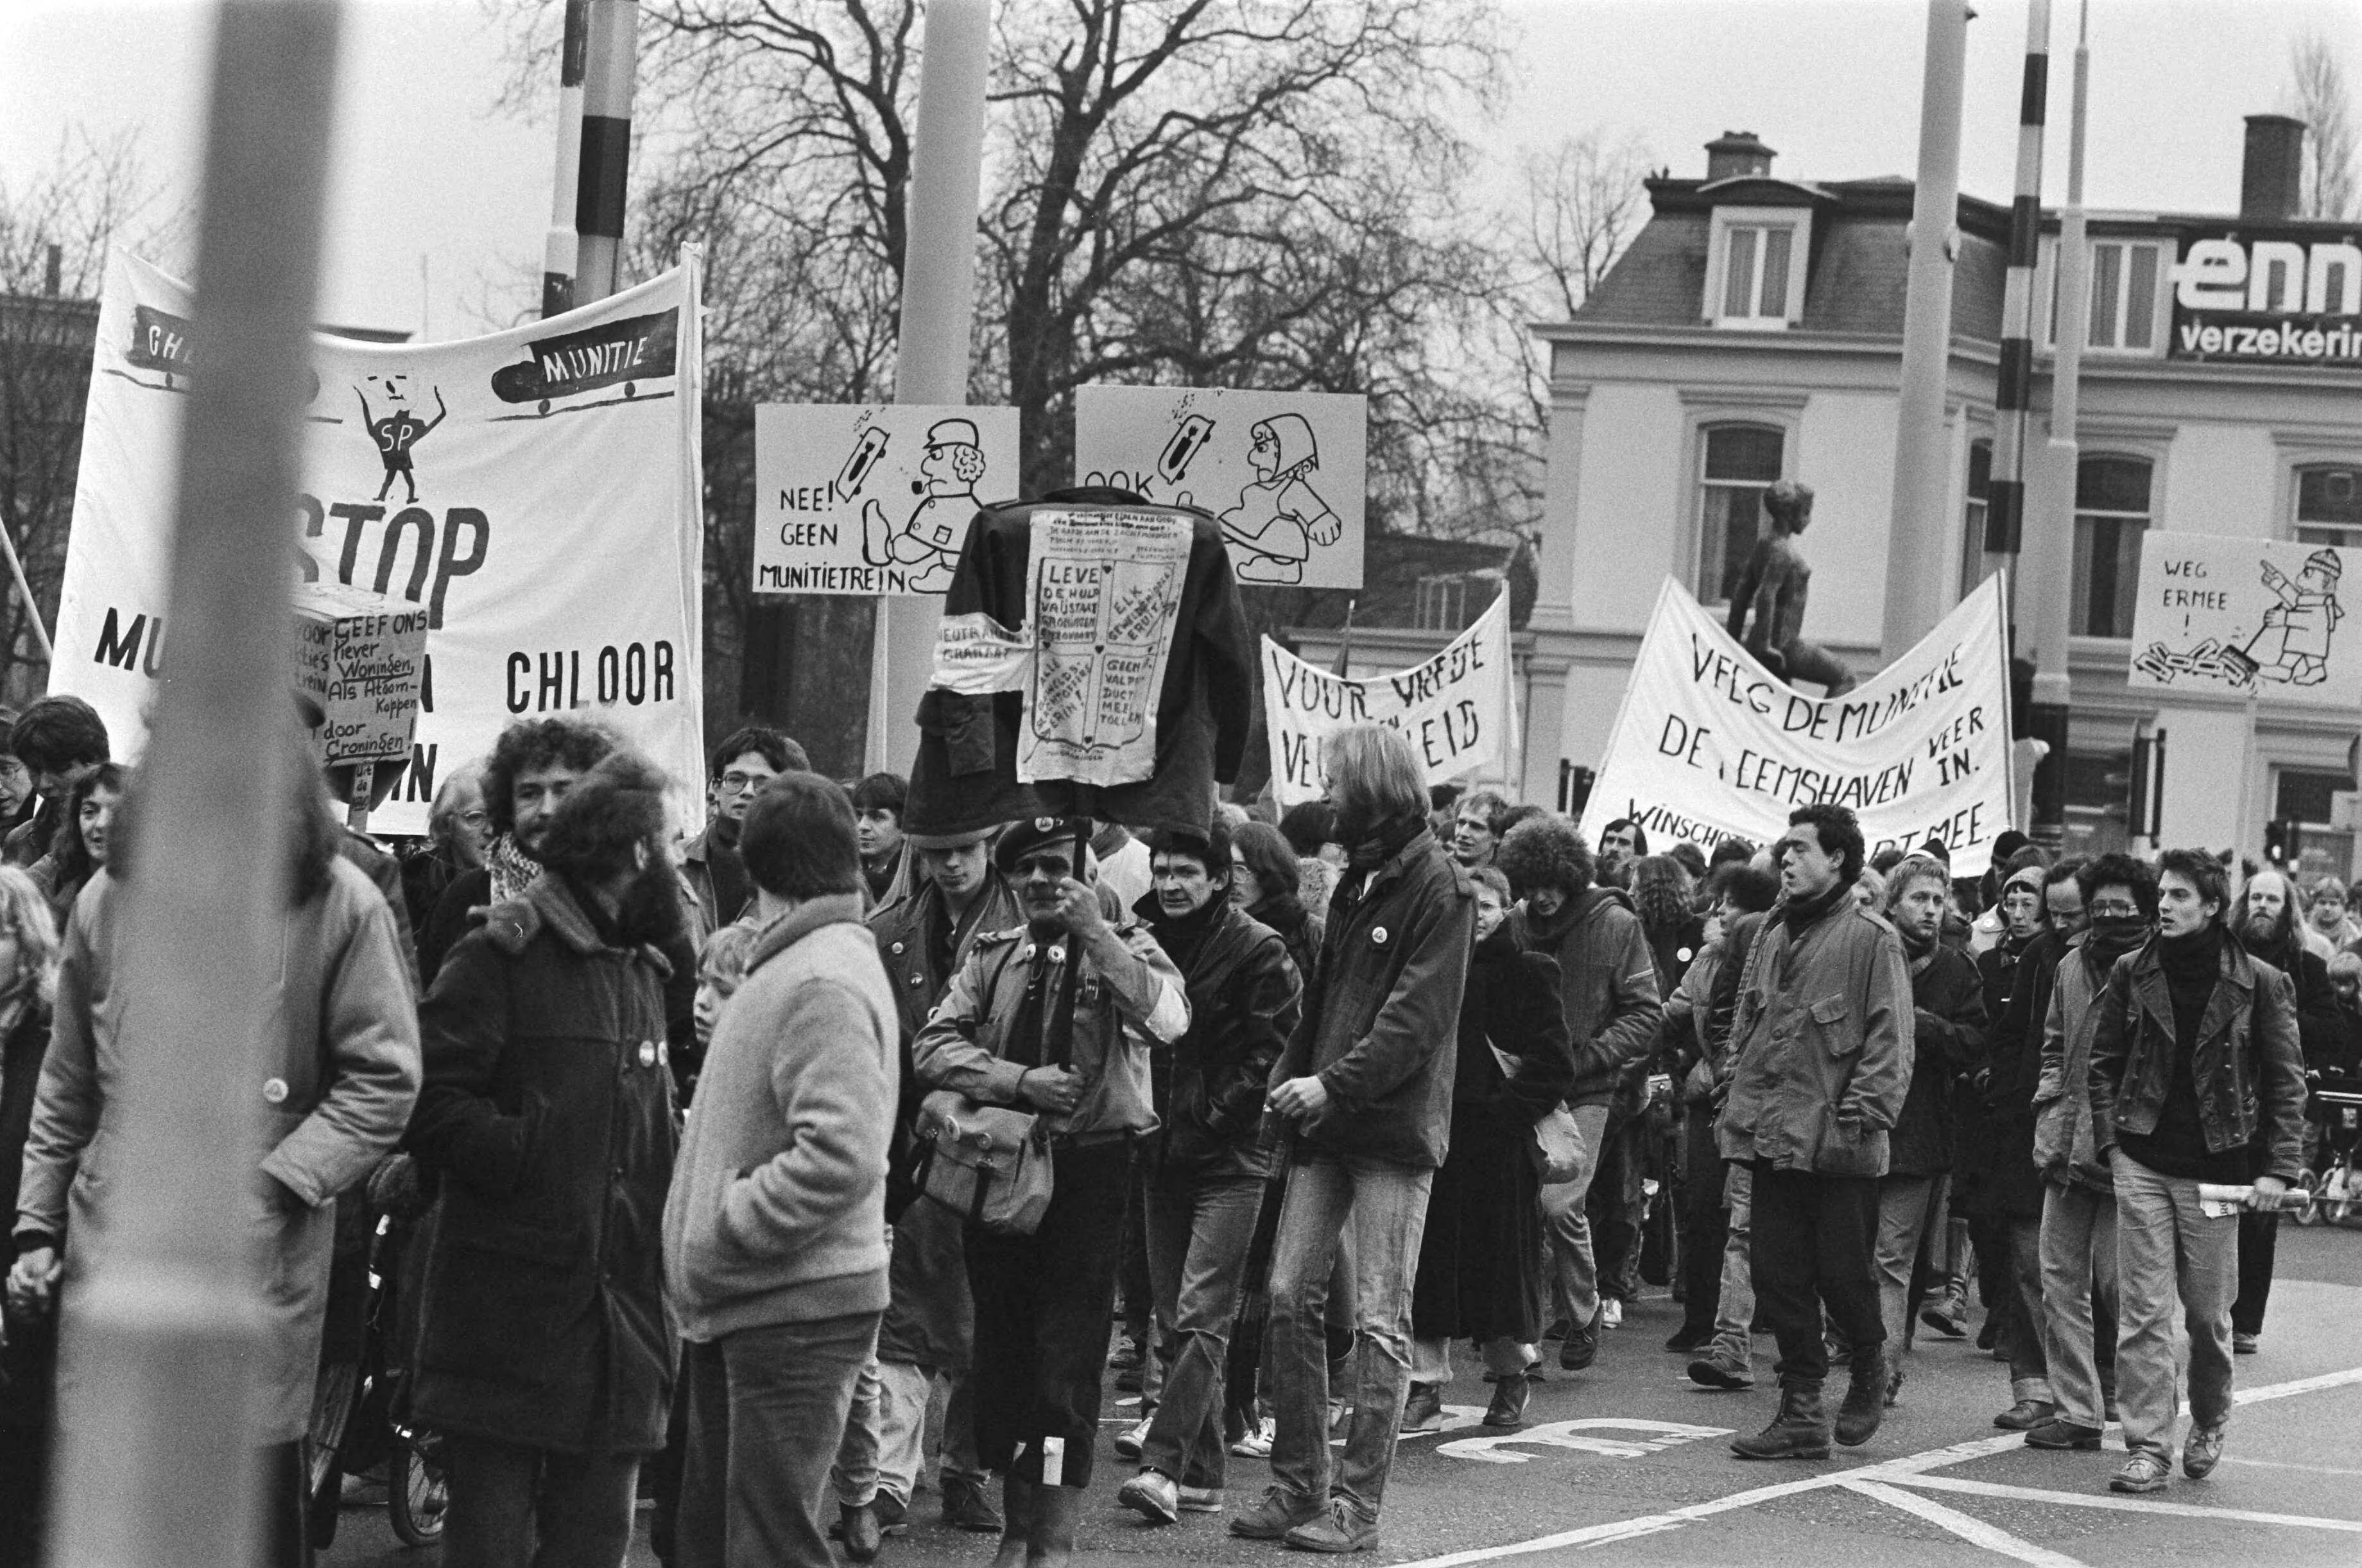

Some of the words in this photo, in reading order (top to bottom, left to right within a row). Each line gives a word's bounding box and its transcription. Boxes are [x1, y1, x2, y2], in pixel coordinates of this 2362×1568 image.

[543, 336, 648, 383] MUNITIE
[381, 424, 413, 451] SP
[780, 481, 834, 511] NEE!
[780, 523, 838, 546] GEEN
[293, 494, 490, 630] STOP
[1049, 565, 1099, 583] LEVE
[2165, 560, 2207, 578] WEG
[759, 562, 905, 593] MUNITIETREIN
[1114, 585, 1142, 621] ELK
[2164, 589, 2227, 610] ERMEE
[334, 615, 388, 641] GEEF
[393, 611, 427, 634] ONS
[506, 640, 674, 714] CHLOOR
[1391, 632, 1484, 708] VREDE
[328, 681, 356, 701] Als
[1783, 695, 1832, 739] DE
[1836, 642, 1963, 743] MUNITIE
[324, 720, 365, 739] door
[1659, 714, 1711, 768] DE
